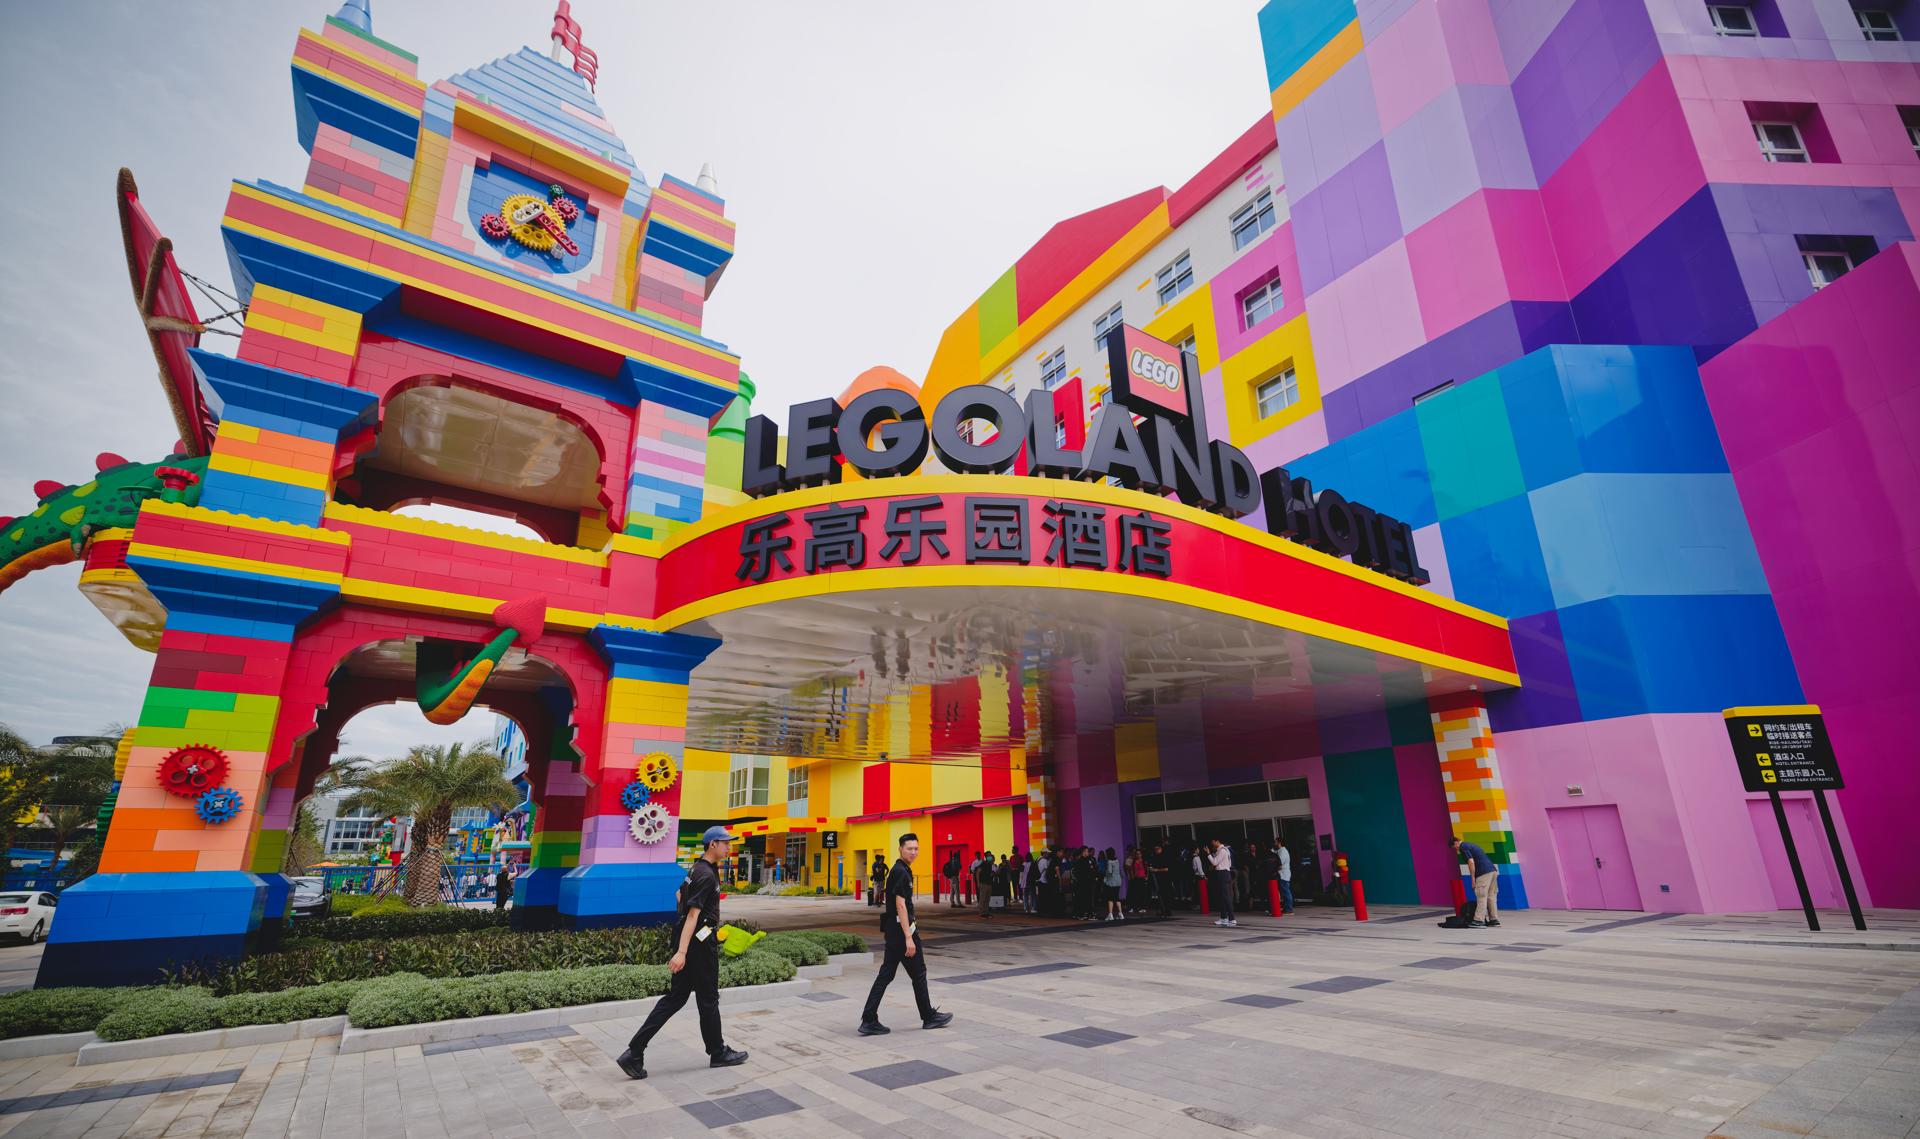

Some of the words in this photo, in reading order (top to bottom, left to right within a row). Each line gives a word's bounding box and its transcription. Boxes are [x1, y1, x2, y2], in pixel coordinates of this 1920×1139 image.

[1131, 349, 1180, 390] LEGO
[743, 352, 1261, 518] LEGOLAND
[1260, 467, 1430, 585] HOTEL
[736, 496, 1171, 580] 乐高乐园酒店
[1778, 769, 1826, 778] 主题乐园入口
